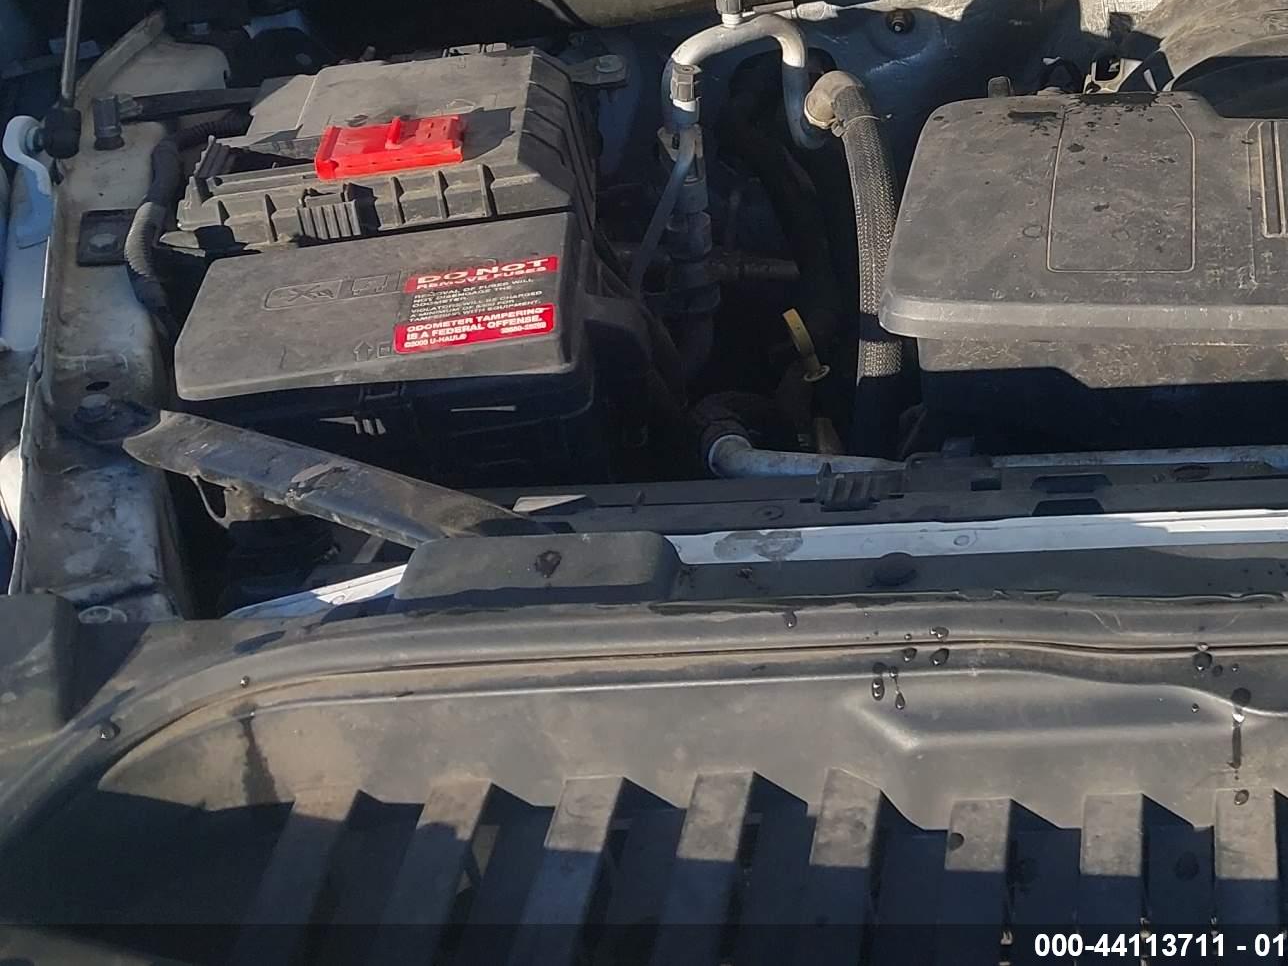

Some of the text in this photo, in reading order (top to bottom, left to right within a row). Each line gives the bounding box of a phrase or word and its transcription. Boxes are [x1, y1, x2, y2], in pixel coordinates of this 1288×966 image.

[416, 267, 547, 290] REMOVE FUSES
[417, 258, 549, 284] DO NOT
[406, 307, 546, 333] ODOMETER TAMPERING
[406, 333, 418, 341] IS
[420, 331, 429, 339] A
[431, 324, 484, 337] FEDERAL
[487, 314, 543, 329] OFFENSE.
